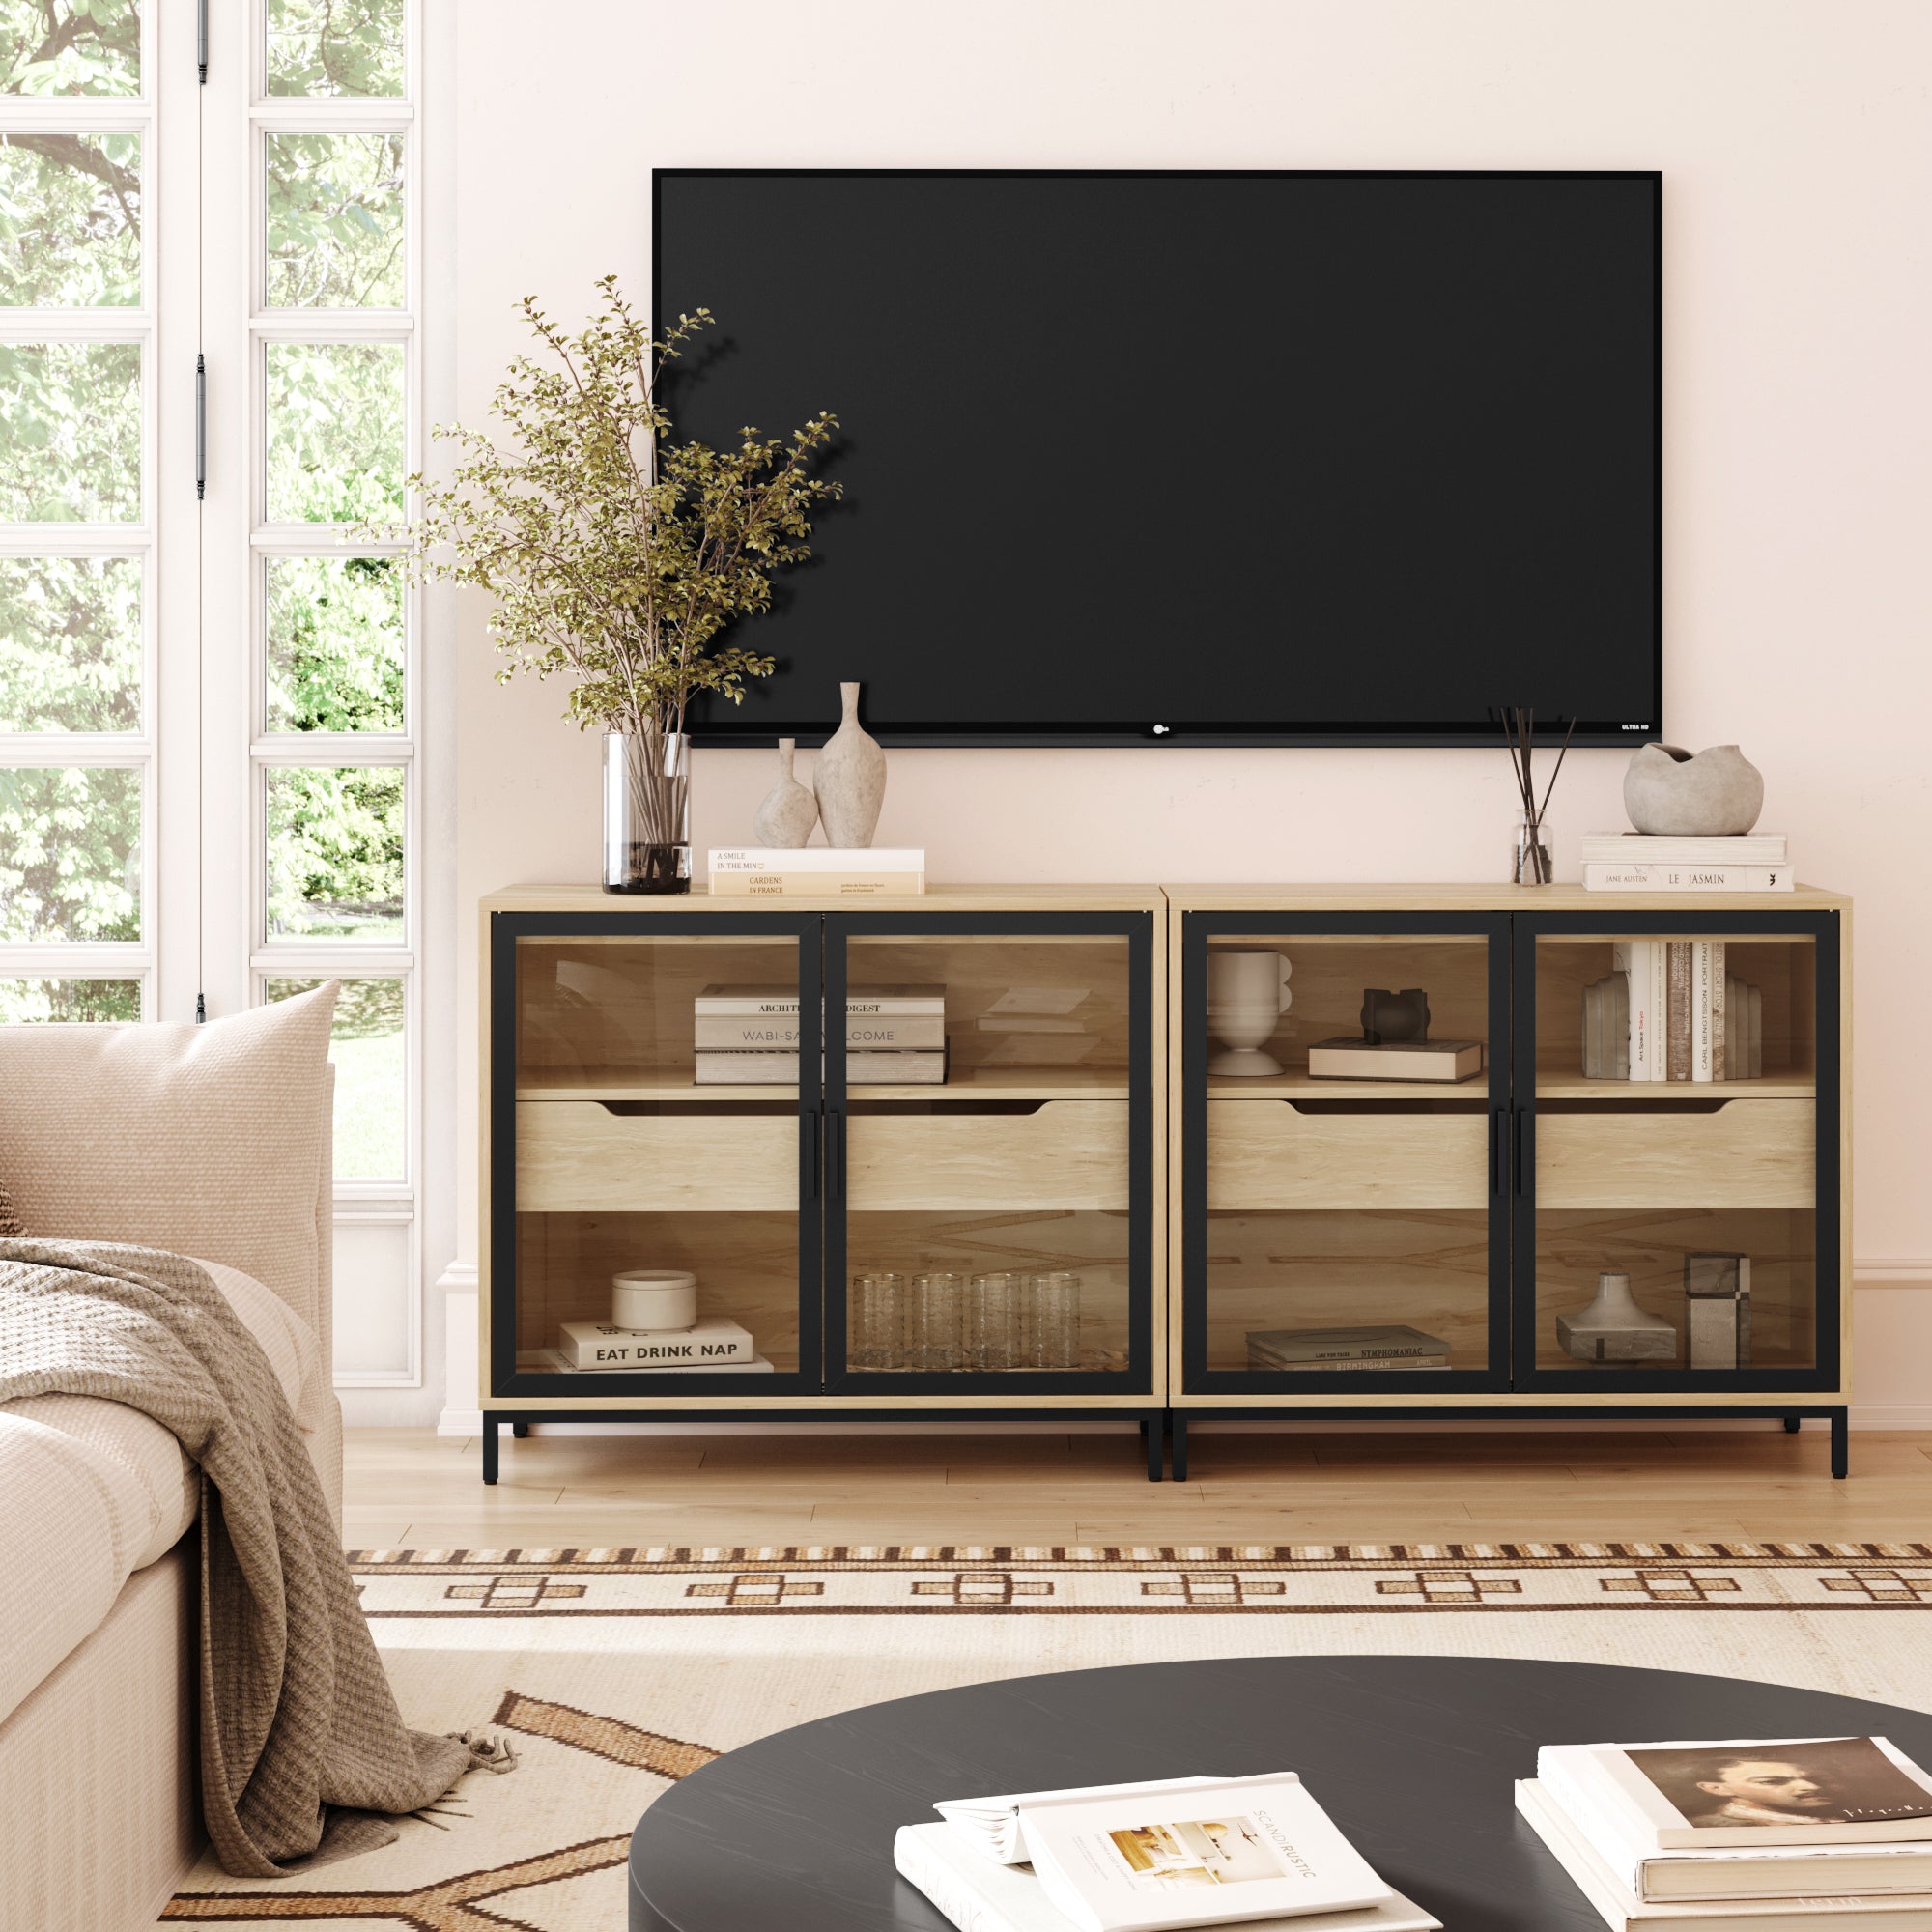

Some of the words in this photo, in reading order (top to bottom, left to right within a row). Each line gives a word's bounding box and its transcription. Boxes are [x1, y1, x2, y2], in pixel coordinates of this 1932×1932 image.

[749, 876, 783, 885] GARDENS
[1605, 874, 1622, 884] JANE
[1668, 873, 1680, 884] LE
[1688, 873, 1725, 886] JASMIN
[1715, 943, 1723, 965] RISTOL
[1715, 967, 1723, 989] SHORT
[846, 1004, 881, 1012] DIGEST
[1715, 1014, 1723, 1032] PRIZE
[596, 1348, 630, 1361] EAT
[636, 1345, 693, 1359] DRINK
[700, 1343, 738, 1357] NAP
[1361, 1347, 1423, 1358] NYMPHOMANIAC
[1336, 1360, 1391, 1371] BIRMINGHAM
[1253, 1809, 1317, 1879] SCANDIRUSTIC
